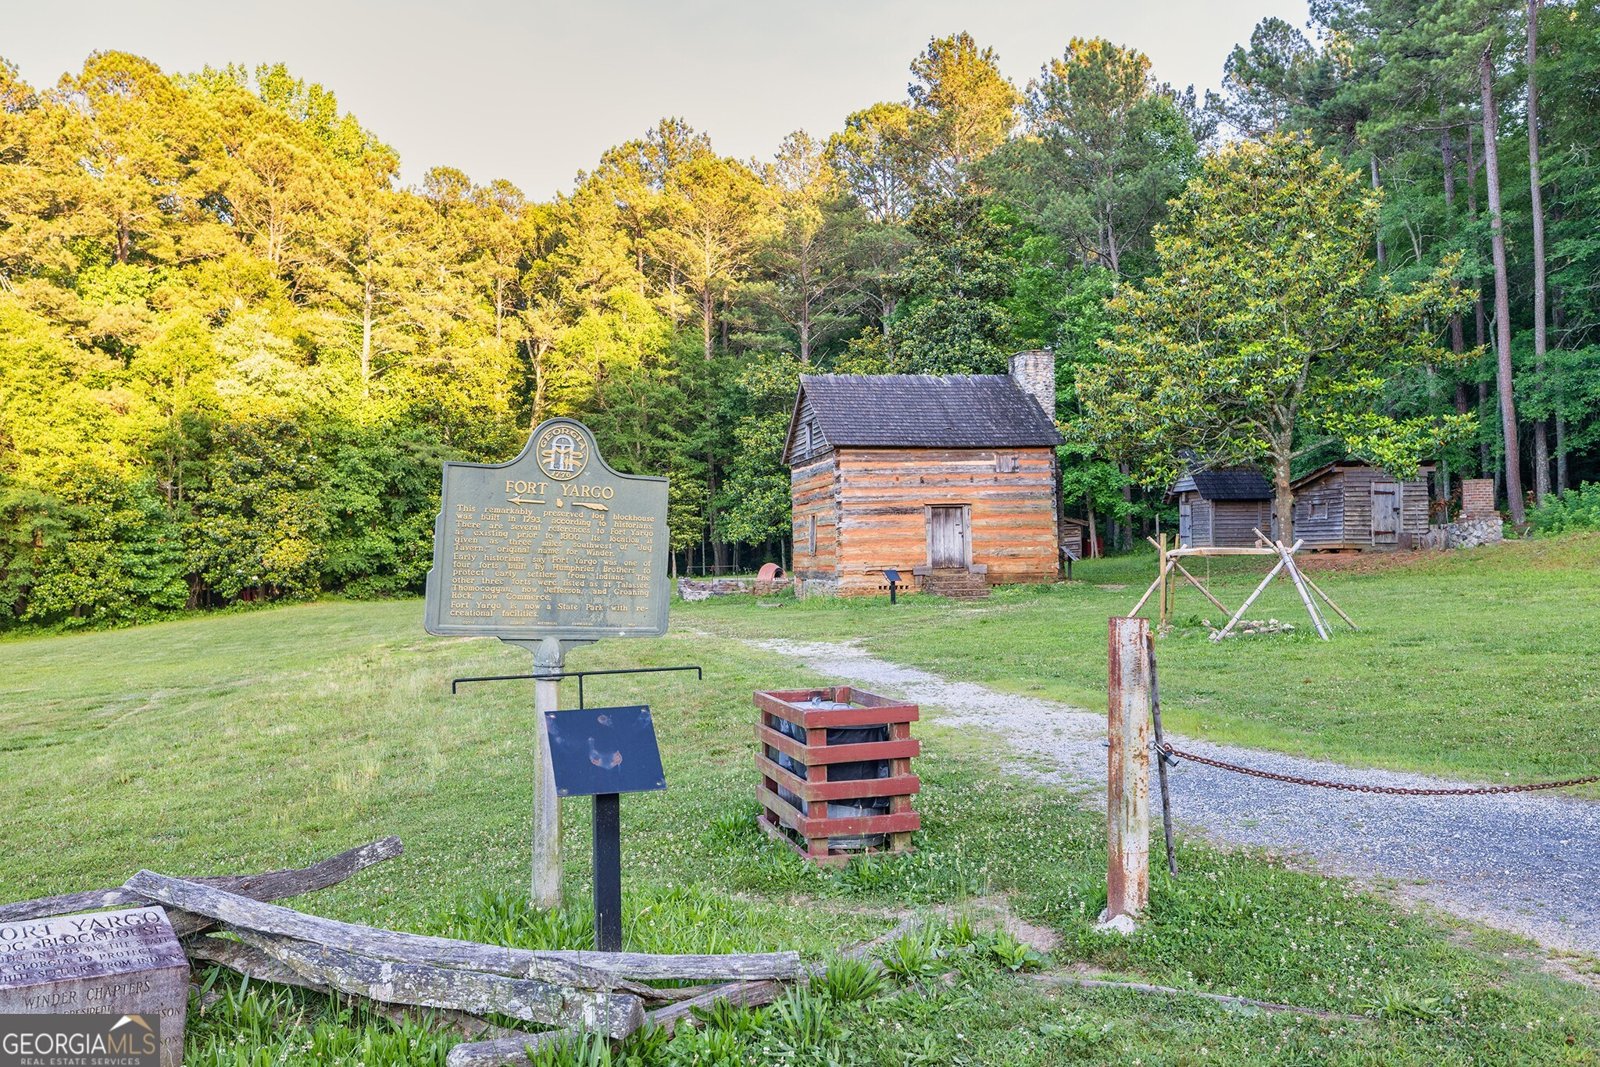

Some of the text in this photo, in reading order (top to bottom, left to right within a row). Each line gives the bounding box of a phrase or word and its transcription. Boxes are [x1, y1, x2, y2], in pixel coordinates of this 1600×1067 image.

[541, 428, 586, 450] GEORGIA
[505, 480, 614, 499] FORT YARGO
[457, 504, 475, 512] This
[484, 507, 532, 516] remarkably
[592, 512, 605, 520] log
[613, 513, 655, 522] blockhouse
[456, 520, 481, 528] There
[511, 523, 541, 531] several
[631, 529, 654, 537] Yargo
[552, 519, 591, 527] according
[455, 536, 478, 544] given
[473, 530, 508, 538] existing
[610, 535, 639, 543] location
[497, 546, 530, 554] original
[453, 553, 476, 561] Early
[484, 554, 525, 562] historians
[575, 558, 597, 566] Yargo
[479, 561, 499, 569] forts
[507, 562, 527, 570] built
[534, 563, 545, 571] by
[495, 570, 516, 578] early
[614, 589, 649, 597] Groaning
[476, 602, 501, 610] Yargo
[0, 911, 160, 941] ORT YARGO
[0, 925, 162, 953] OG BLOCKHOUSE
[137, 937, 169, 946] STATE
[13, 959, 70, 971] GEORGIA
[99, 948, 152, 960] PROTECT
[0, 953, 183, 982] HITE SETTLERS FROM INDIANS
[23, 980, 150, 1009] WINDER CHAPTERS
